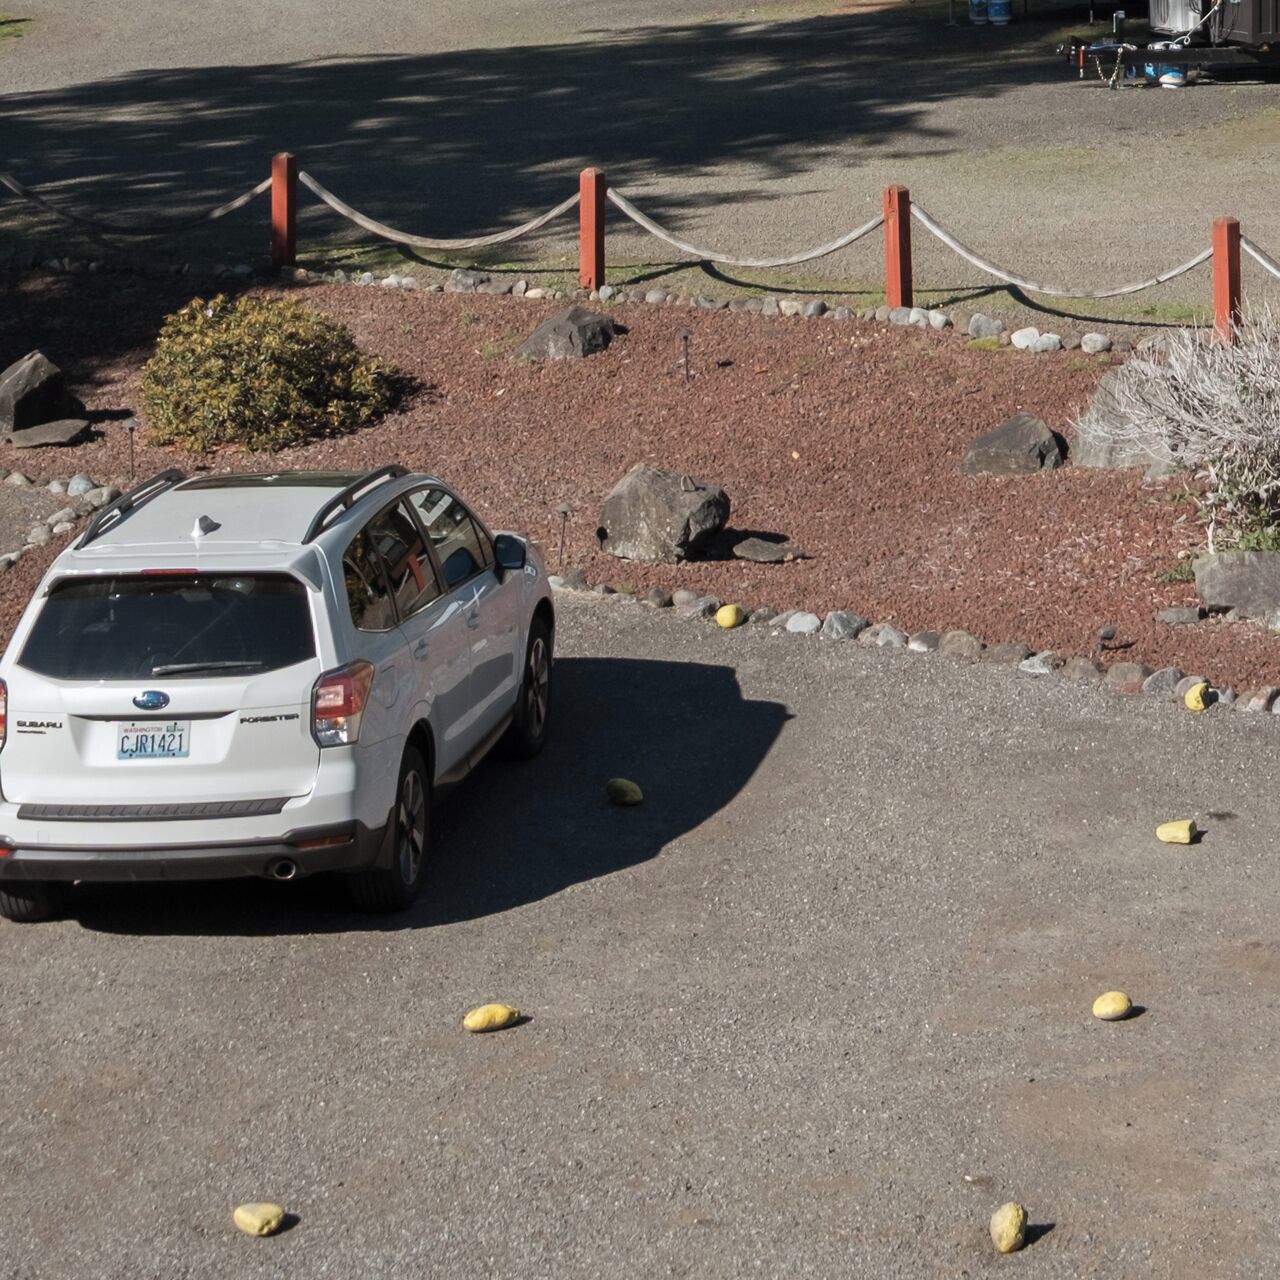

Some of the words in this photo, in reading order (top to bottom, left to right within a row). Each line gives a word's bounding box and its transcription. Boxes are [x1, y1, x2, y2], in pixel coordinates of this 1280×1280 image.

[17, 720, 62, 728] SUBARU
[240, 713, 299, 724] FORESTER
[121, 733, 183, 754] CJR1421
